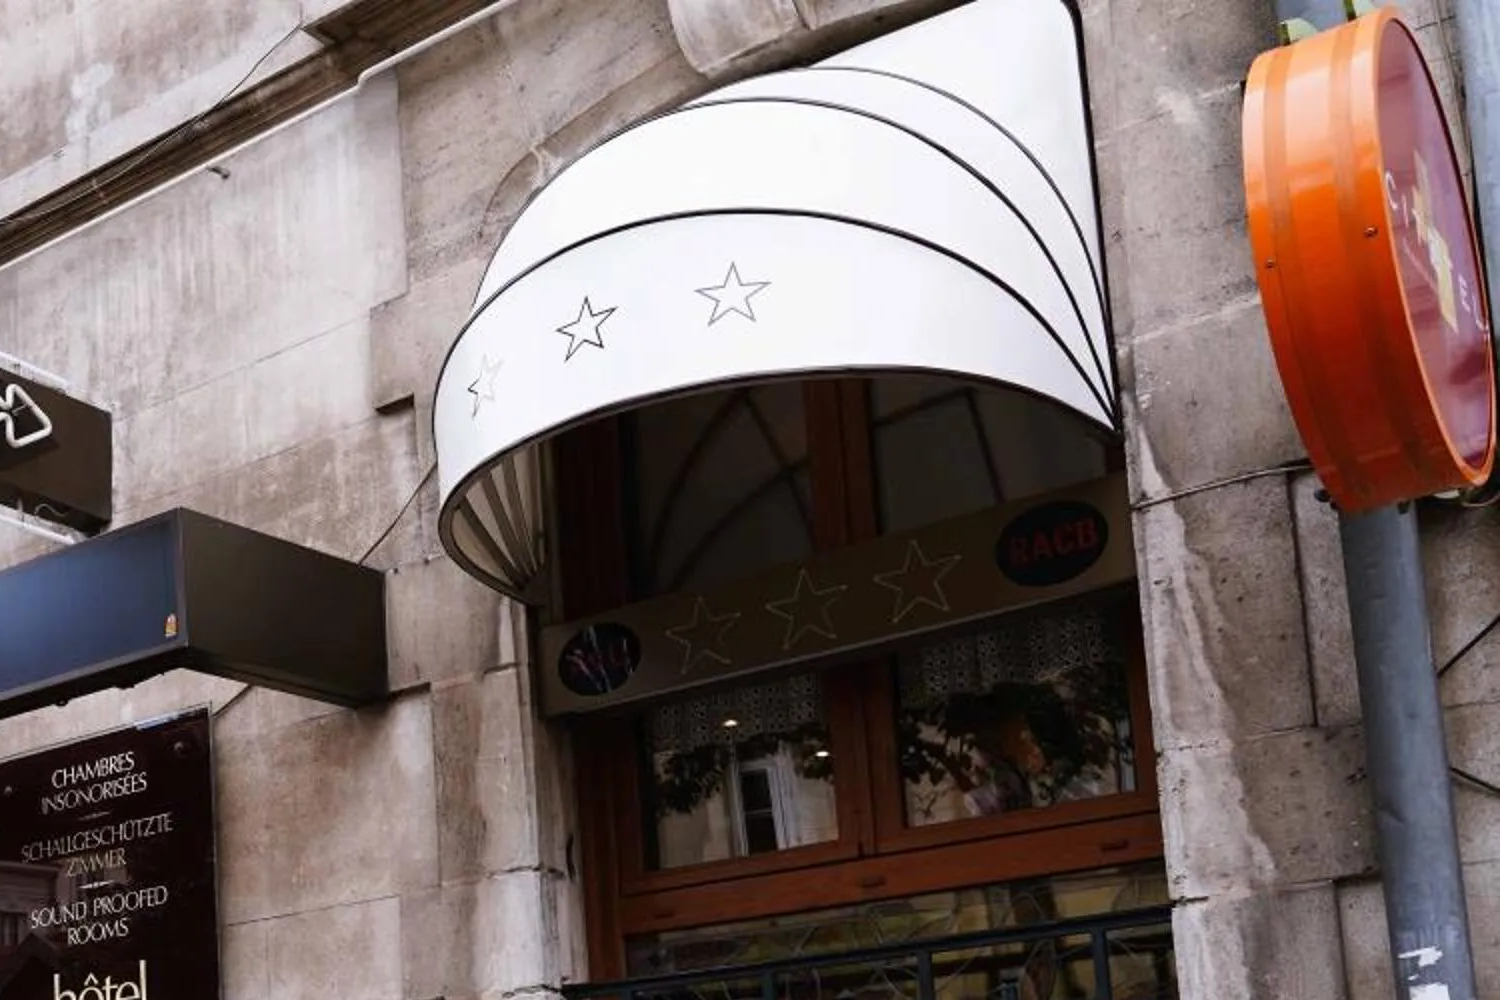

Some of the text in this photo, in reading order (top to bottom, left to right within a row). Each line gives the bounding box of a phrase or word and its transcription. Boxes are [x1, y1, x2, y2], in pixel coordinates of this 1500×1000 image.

[1008, 515, 1100, 568] RACB
[52, 750, 136, 790] CHAMBRES
[41, 771, 149, 815] INSONORISÉES
[21, 811, 175, 864] SCHALLGESCHÜTZTE
[67, 847, 128, 879] ZIMMER
[30, 884, 170, 930] SOUND PROOFED
[67, 918, 130, 947] ROOMS
